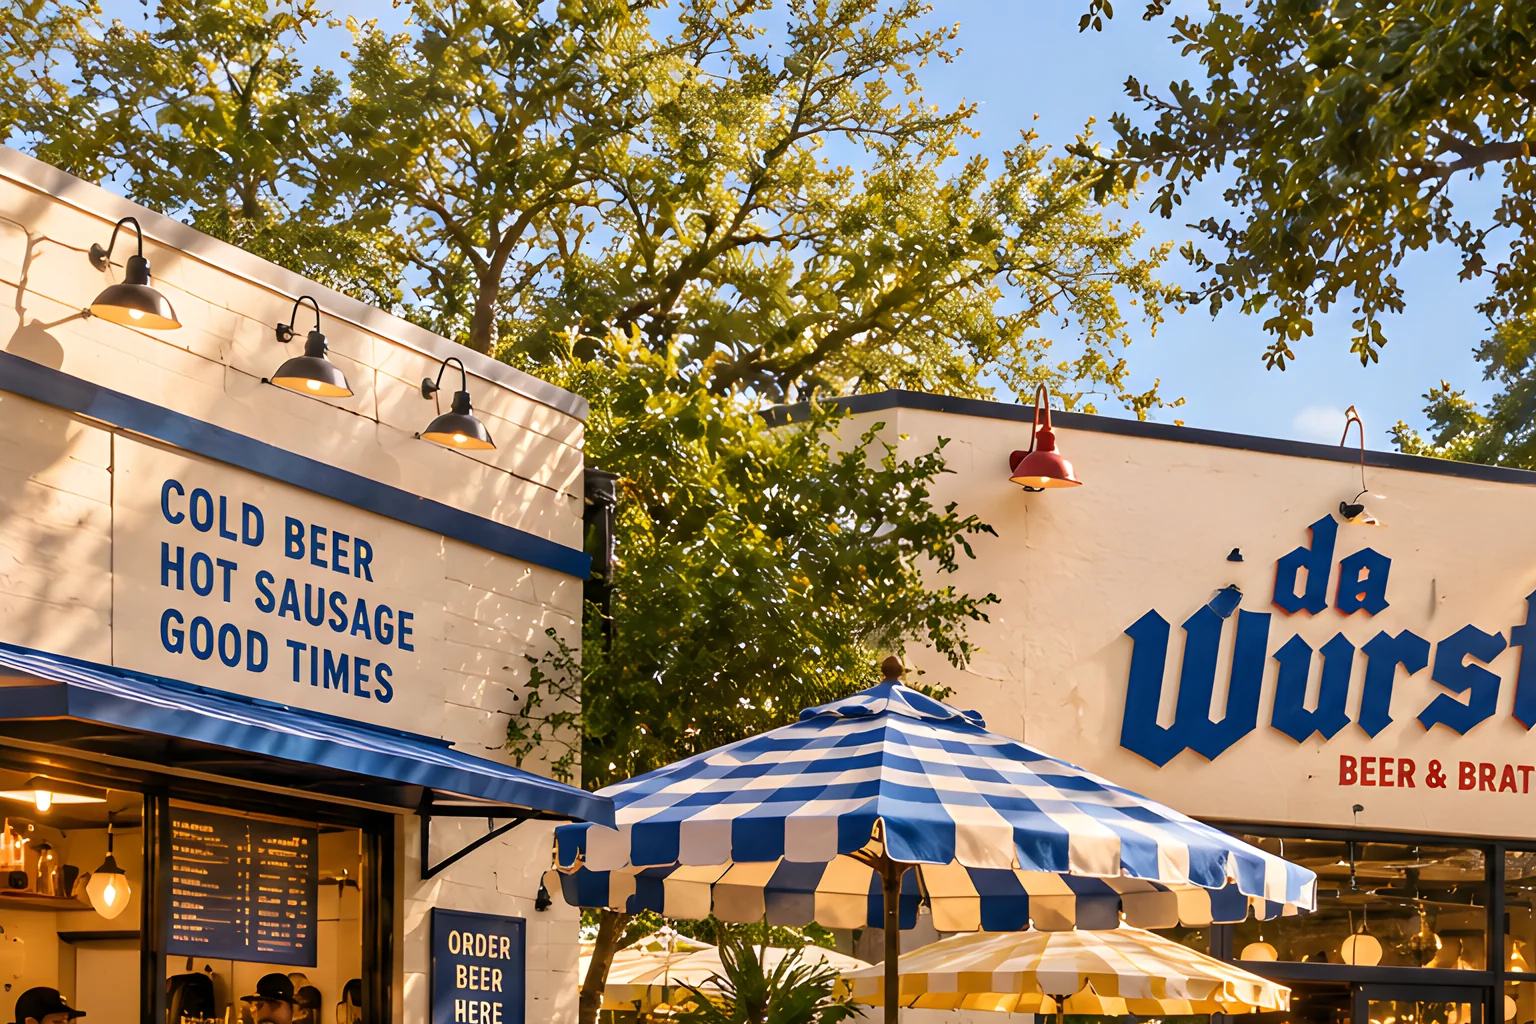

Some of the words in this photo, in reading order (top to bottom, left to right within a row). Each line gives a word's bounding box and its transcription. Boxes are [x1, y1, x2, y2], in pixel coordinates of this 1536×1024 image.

[161, 479, 265, 548] COLD
[284, 516, 373, 582] BEER
[1272, 513, 1392, 616] da
[161, 541, 239, 603] HOT
[255, 569, 415, 653] SAUSAGE
[160, 607, 269, 673] GOOD
[286, 638, 394, 704] TIMES
[1338, 754, 1416, 789] BEER
[1425, 758, 1447, 790] &
[448, 930, 511, 959] ORDER
[456, 964, 503, 992] BEER
